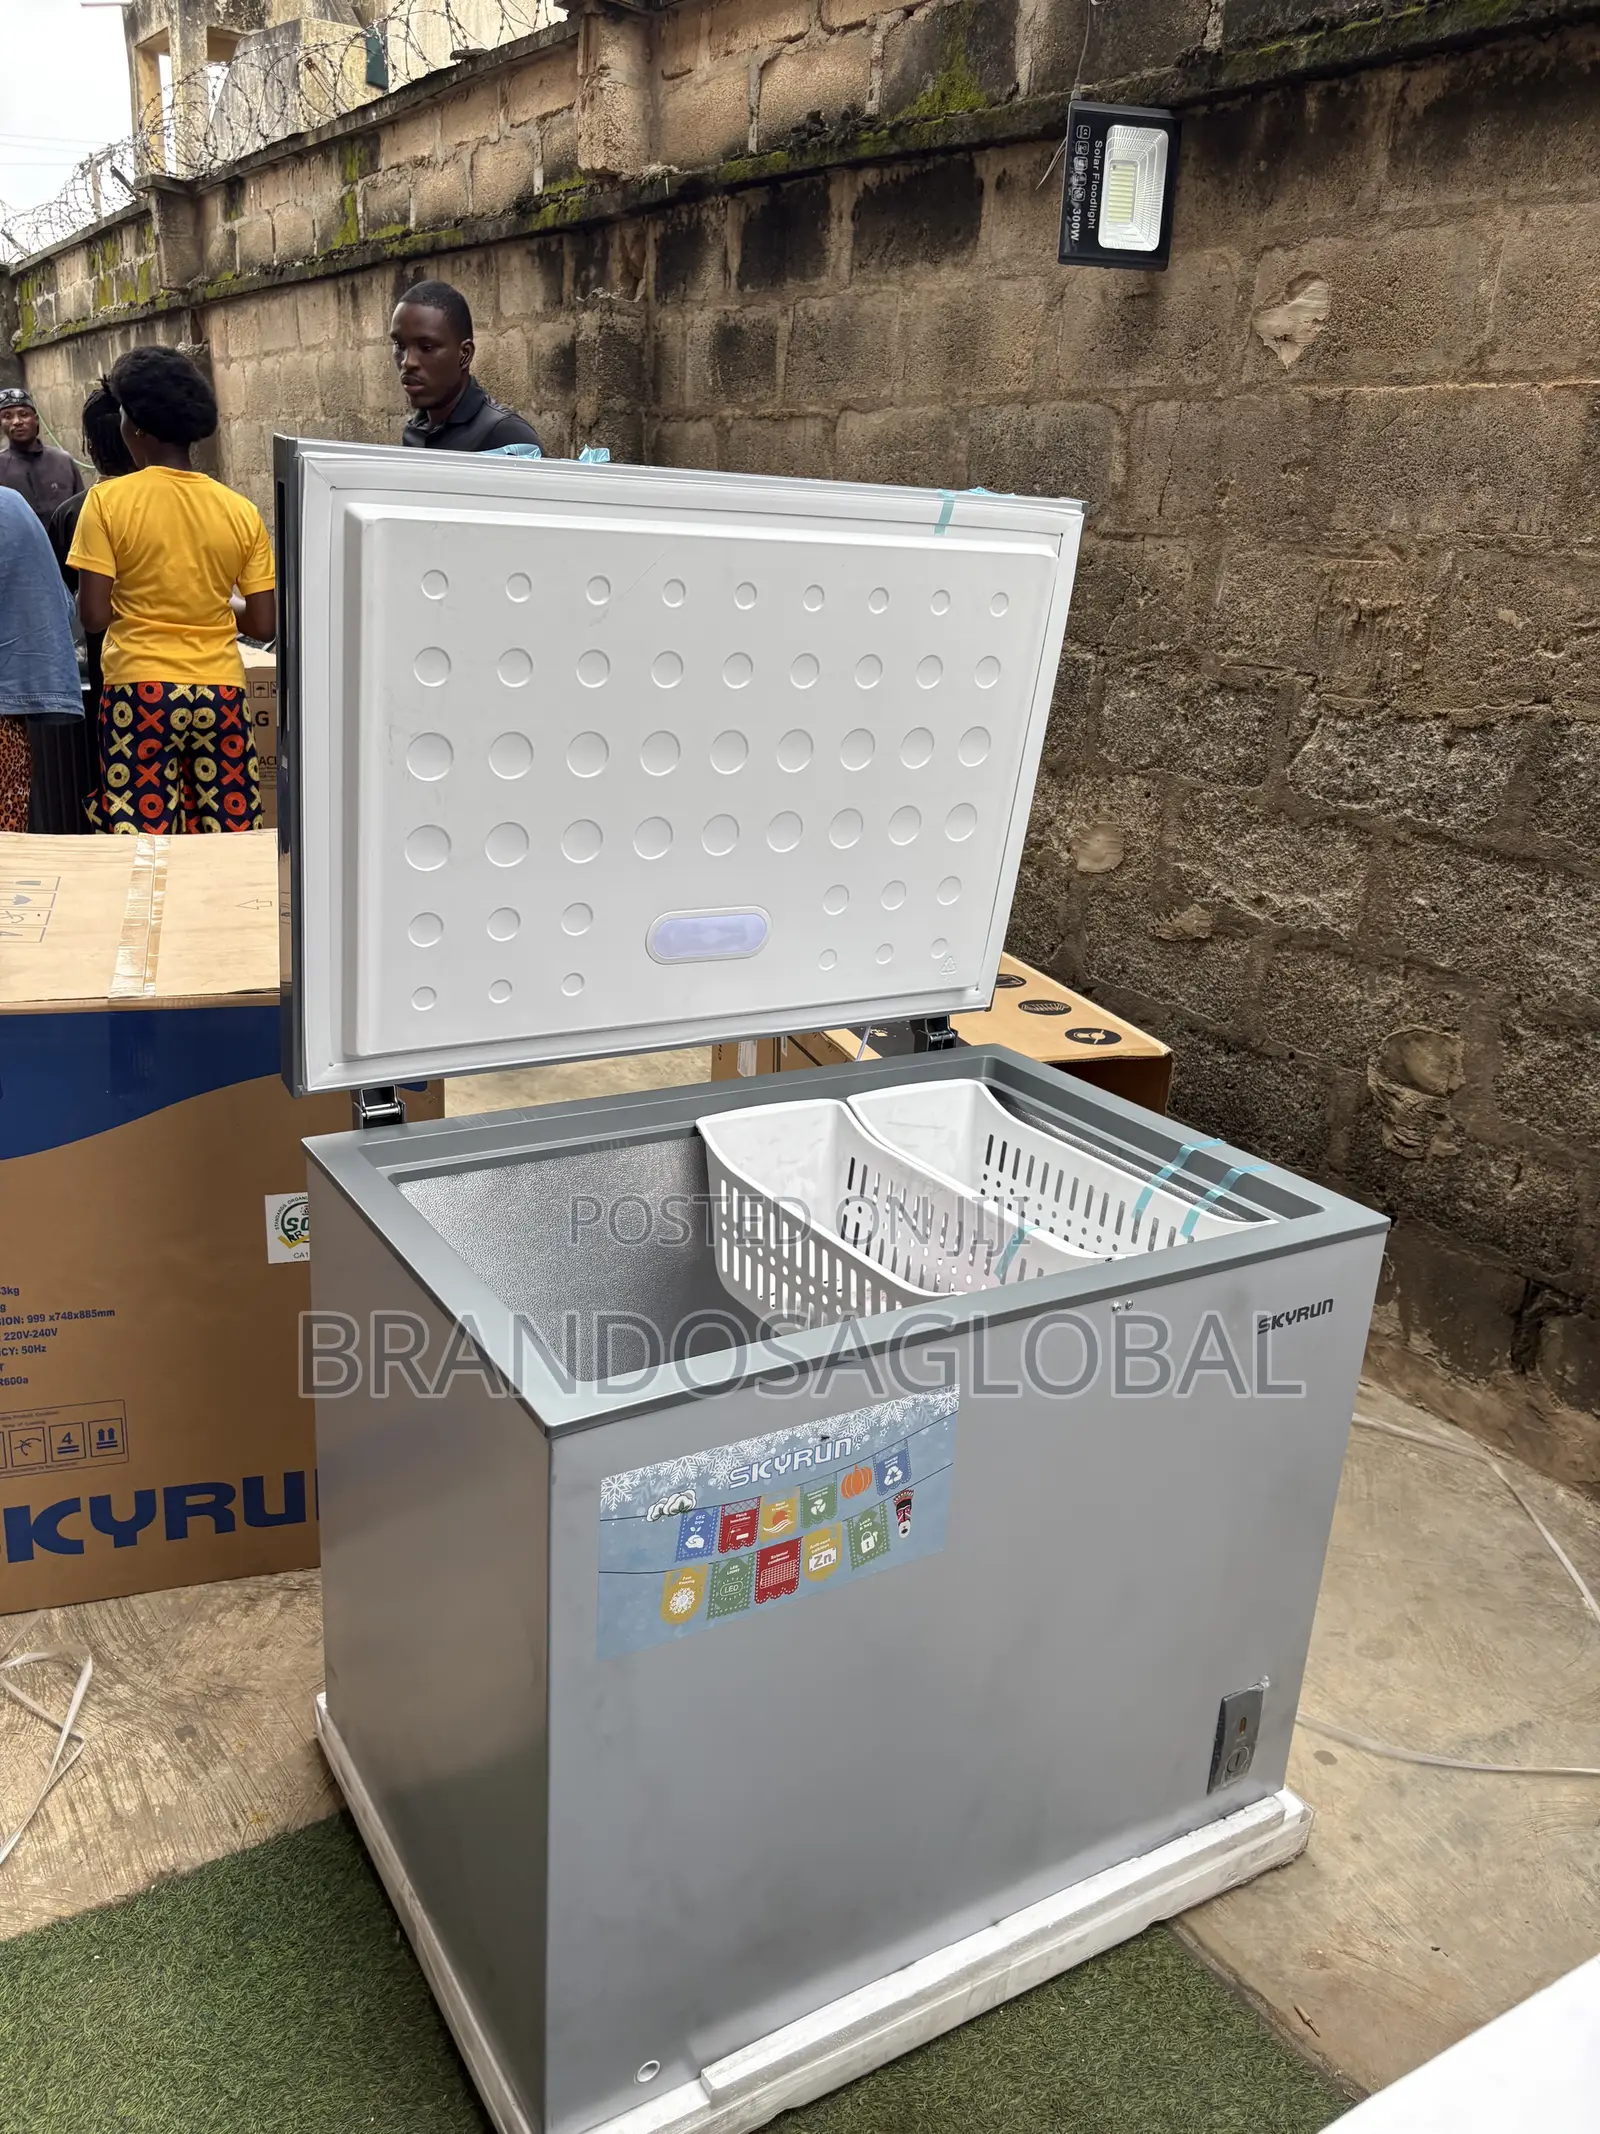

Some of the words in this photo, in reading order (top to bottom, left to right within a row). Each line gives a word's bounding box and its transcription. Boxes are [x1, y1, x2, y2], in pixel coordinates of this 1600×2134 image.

[1093, 140, 1102, 170] Solar
[1088, 173, 1099, 229] Floodlight
[1070, 208, 1081, 241] 300W
[0, 1286, 20, 1296] 3kg
[27, 1314, 46, 1324] 999
[48, 1309, 116, 1322] x748x885mm
[1257, 1298, 1334, 1335] SKYRUN
[3, 1328, 58, 1341] 220V-240V
[21, 1344, 47, 1355] 50Hz
[728, 1437, 853, 1491] SKYRUN
[813, 1553, 832, 1569] Zn
[724, 1584, 739, 1594] LED
